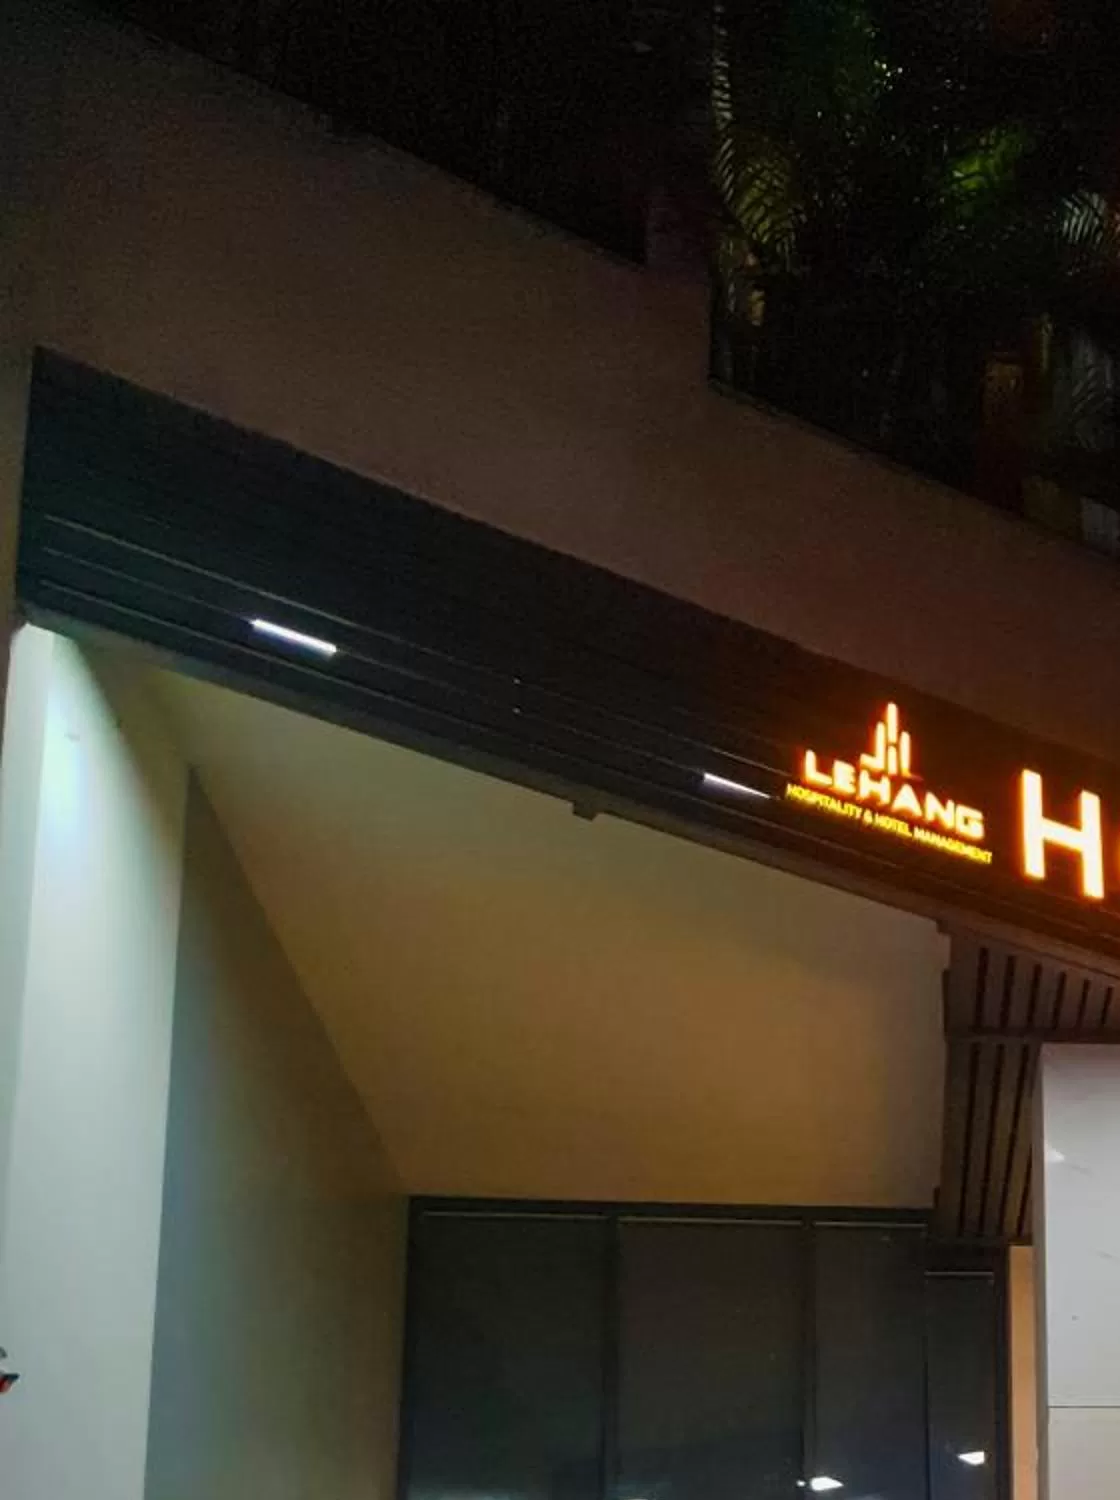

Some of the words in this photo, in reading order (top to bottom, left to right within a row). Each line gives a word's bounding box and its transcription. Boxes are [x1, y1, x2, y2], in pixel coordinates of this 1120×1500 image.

[786, 783, 862, 819] HOSPITALITY
[874, 812, 913, 837] HOTEL
[913, 826, 993, 864] MANAGEMENT
[803, 749, 985, 841] LEHANG
